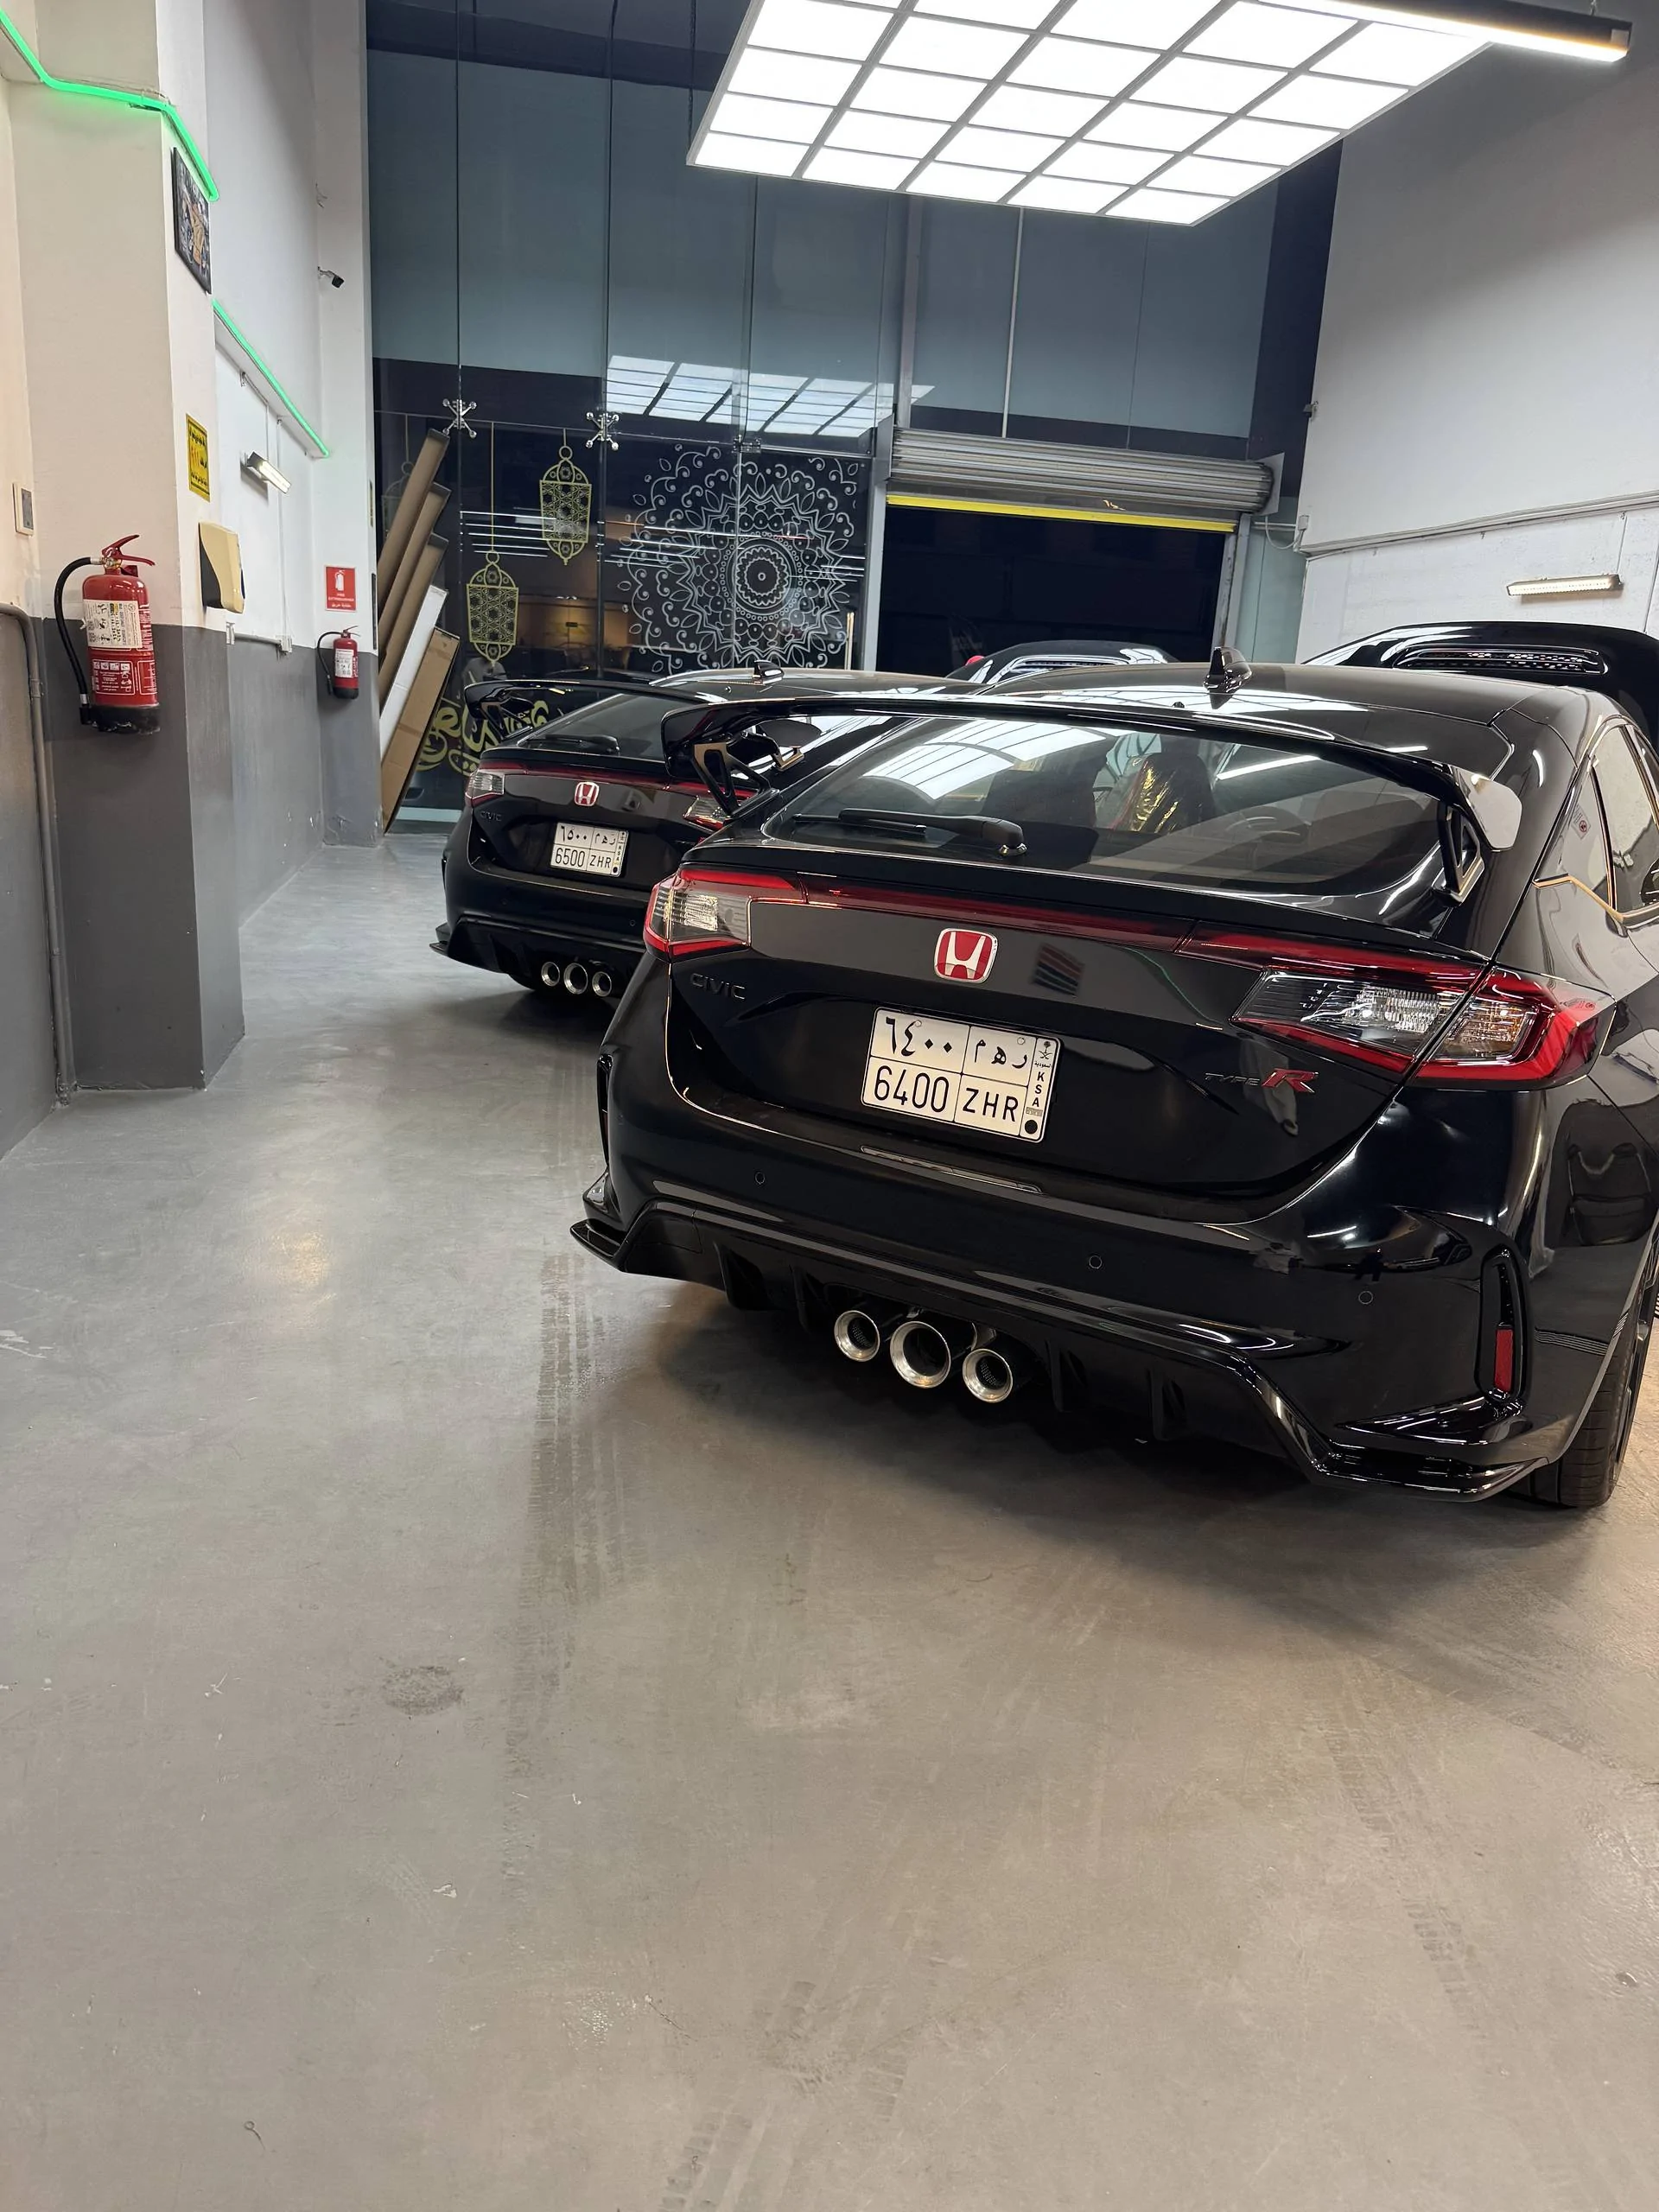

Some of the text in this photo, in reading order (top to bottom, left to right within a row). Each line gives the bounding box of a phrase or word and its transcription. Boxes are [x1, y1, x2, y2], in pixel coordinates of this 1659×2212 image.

[555, 848, 612, 868] 6500 ZHR
[690, 973, 746, 1000] CIVIC
[885, 1016, 953, 1057] ٦٤٠٠
[874, 1065, 1019, 1122] 6400 ZHR
[1205, 1067, 1319, 1093] TYPE R
